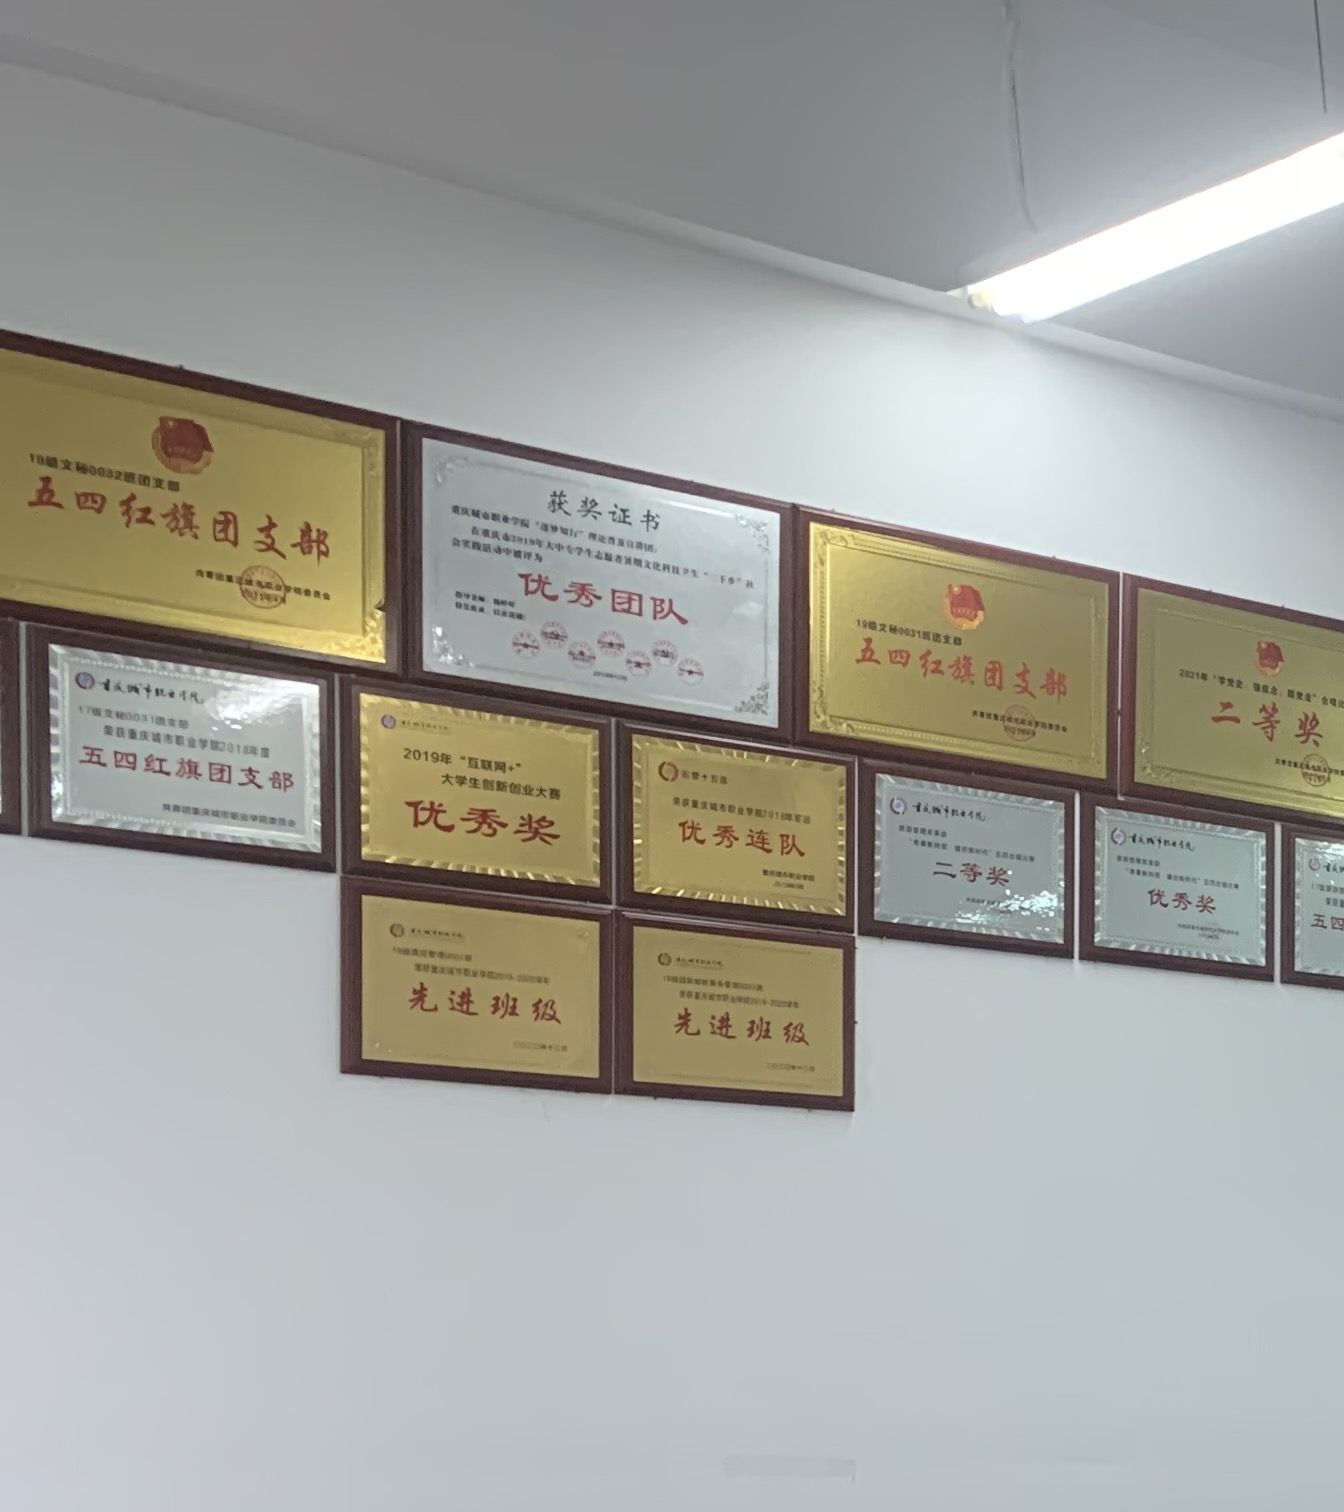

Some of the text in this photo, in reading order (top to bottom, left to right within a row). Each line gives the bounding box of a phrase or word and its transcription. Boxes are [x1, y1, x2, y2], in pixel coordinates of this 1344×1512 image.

[28, 476, 330, 567] 五四红旗团支部
[549, 489, 661, 533] 获奖证书
[518, 571, 689, 626] 优秀团队
[854, 636, 1069, 704] 五四红旗团支部
[1211, 701, 1324, 749] 二等奖
[79, 745, 295, 793] 五四红旗团支部
[403, 747, 523, 774] 2019年“互联网+”
[441, 773, 562, 801] 大学生创新创业大赛
[404, 799, 561, 846] 优秀奖
[678, 819, 806, 857] 优秀连队
[933, 861, 1010, 887] 二等奖
[1147, 887, 1217, 915] 优秀奖
[408, 982, 562, 1025] 先进班级
[673, 1007, 810, 1047] 先进班级
